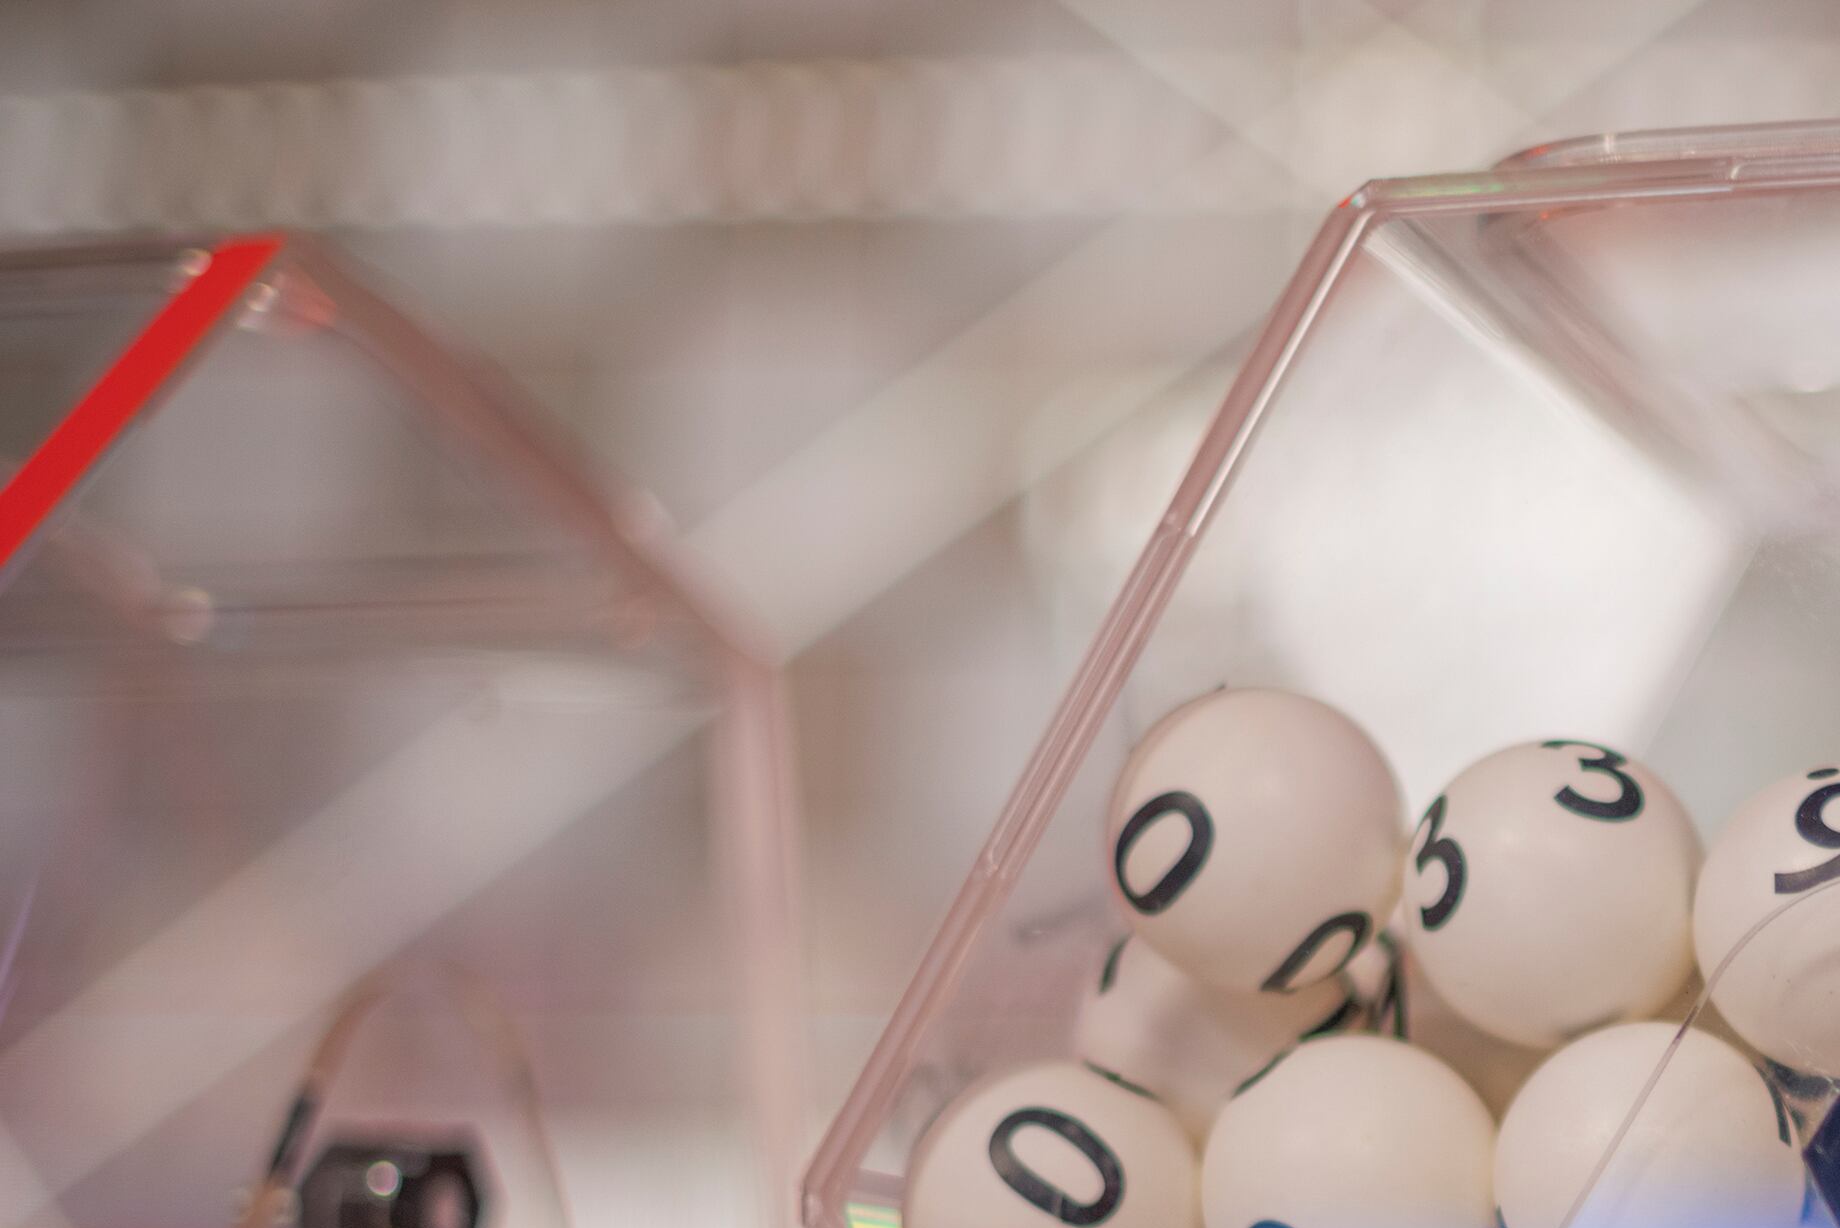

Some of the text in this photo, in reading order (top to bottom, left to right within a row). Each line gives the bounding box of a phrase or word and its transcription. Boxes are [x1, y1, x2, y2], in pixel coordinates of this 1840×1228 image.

[1540, 738, 1645, 822] 3
[1115, 790, 1215, 916] 0
[1415, 795, 1468, 932] 3
[988, 1106, 1126, 1228] 0
